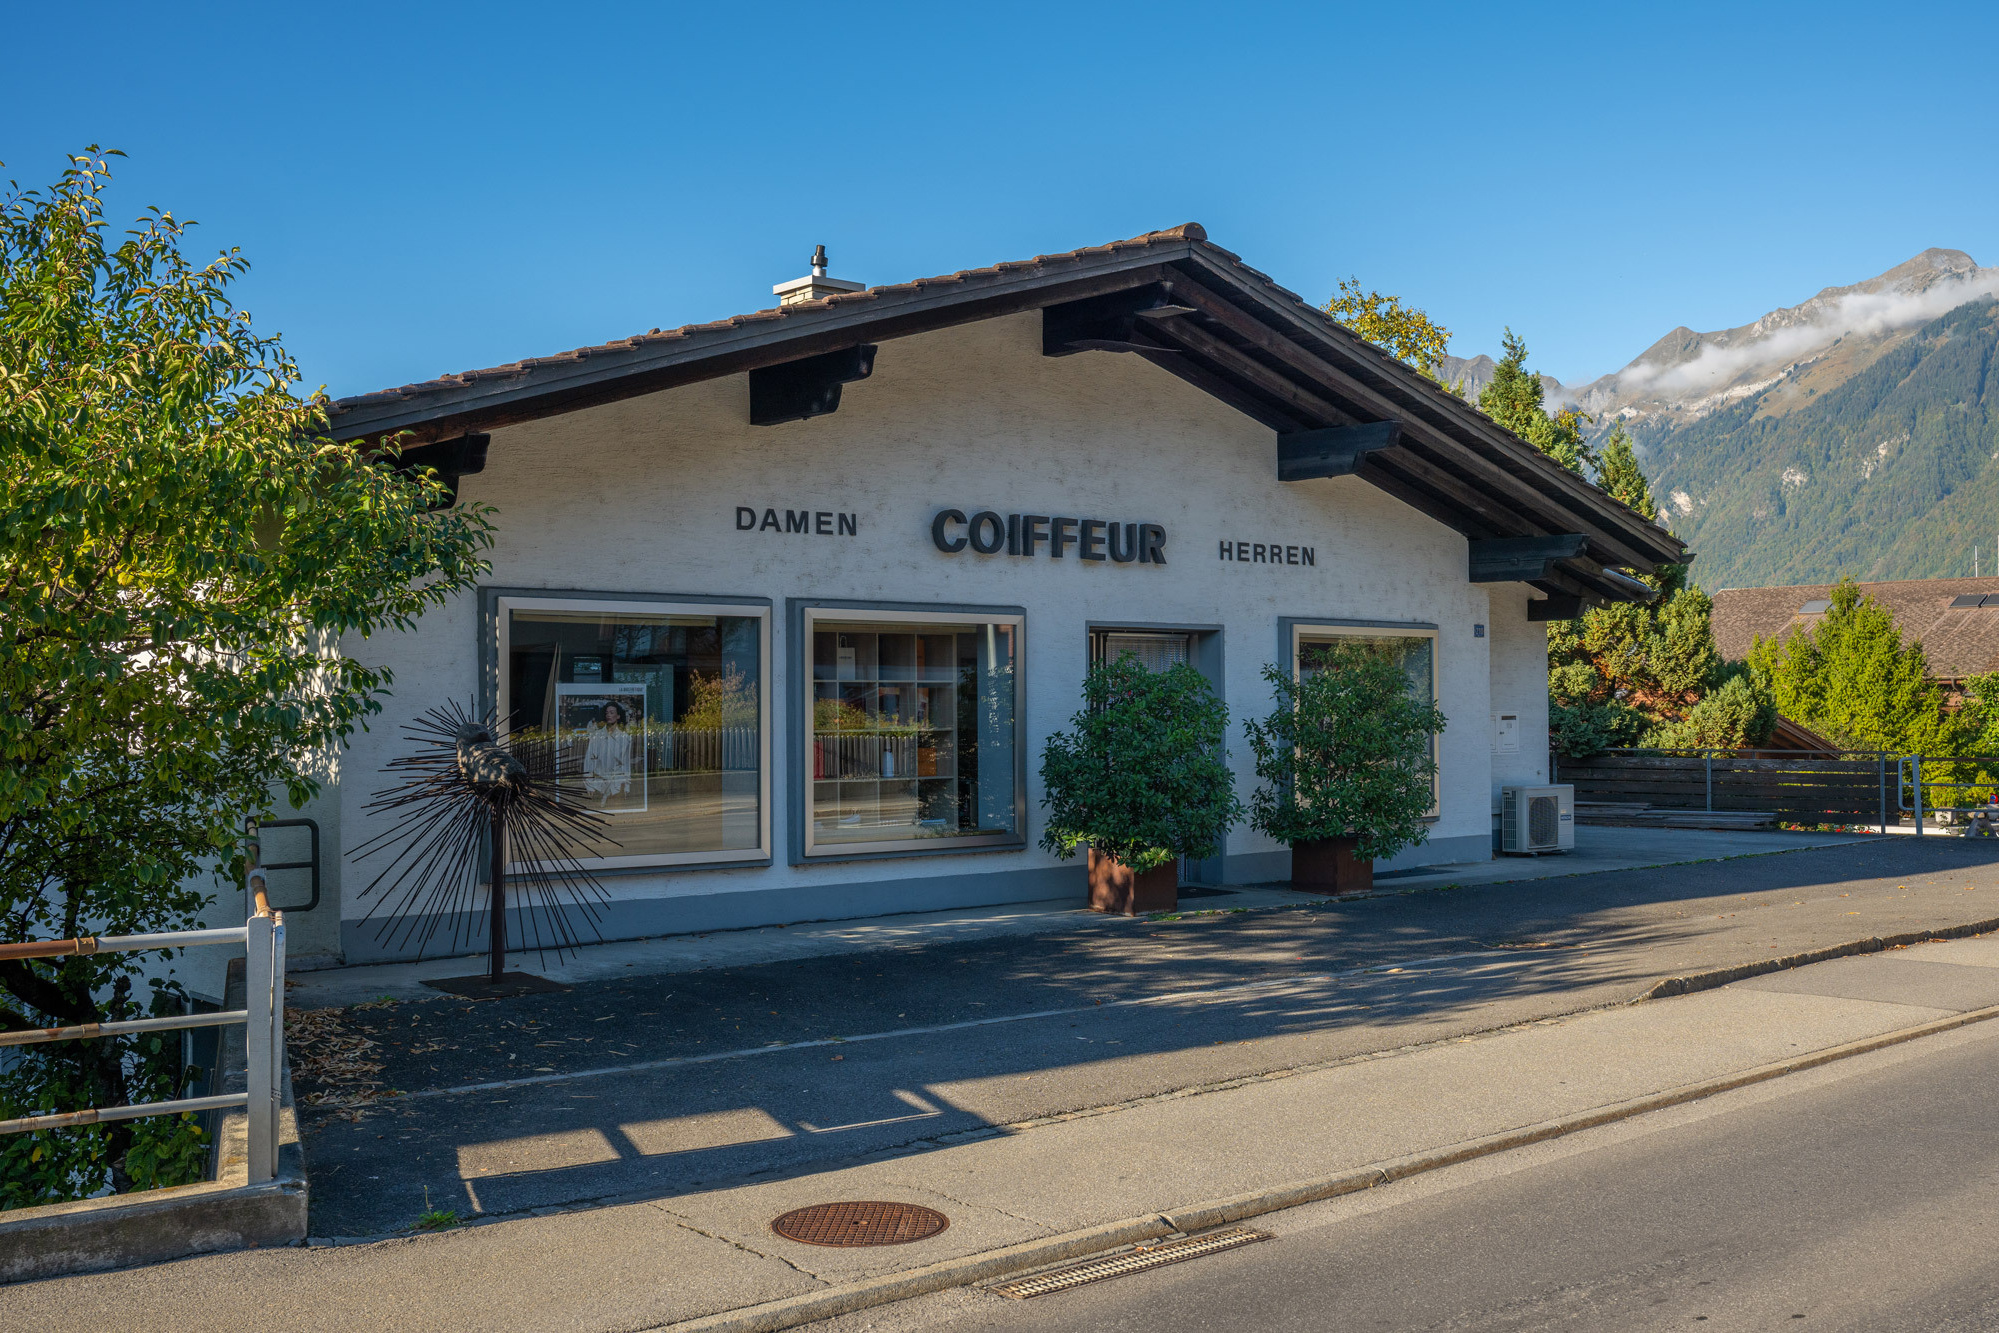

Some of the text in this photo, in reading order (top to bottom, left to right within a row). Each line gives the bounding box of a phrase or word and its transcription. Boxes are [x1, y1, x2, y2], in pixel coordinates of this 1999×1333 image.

[736, 507, 857, 537] DAMEN
[931, 508, 1167, 565] COIFFEUR
[1220, 540, 1315, 567] HERREN
